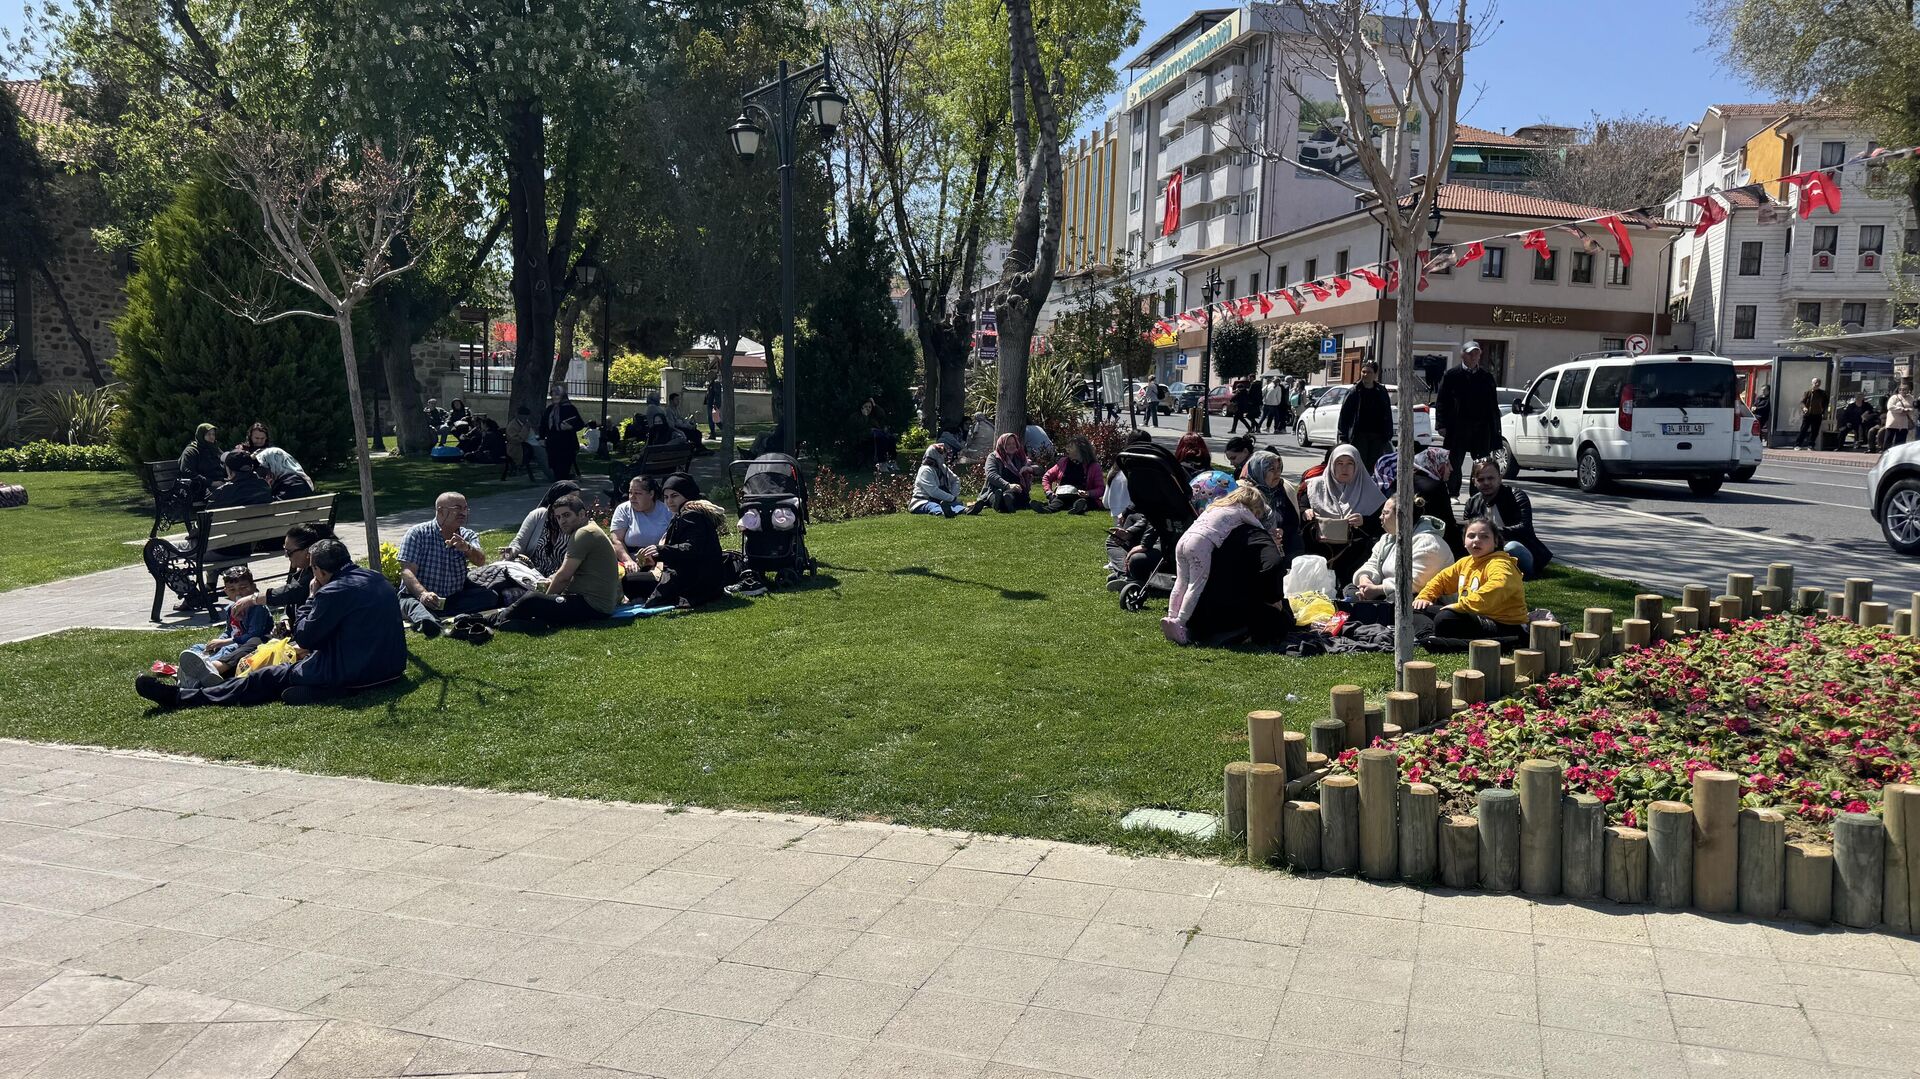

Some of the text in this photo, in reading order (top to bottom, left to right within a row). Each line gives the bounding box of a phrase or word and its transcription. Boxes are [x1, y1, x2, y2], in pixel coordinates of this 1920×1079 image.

[1504, 310, 1530, 323] Ziraat
[1324, 340, 1333, 352] P
[1178, 354, 1185, 364] P
